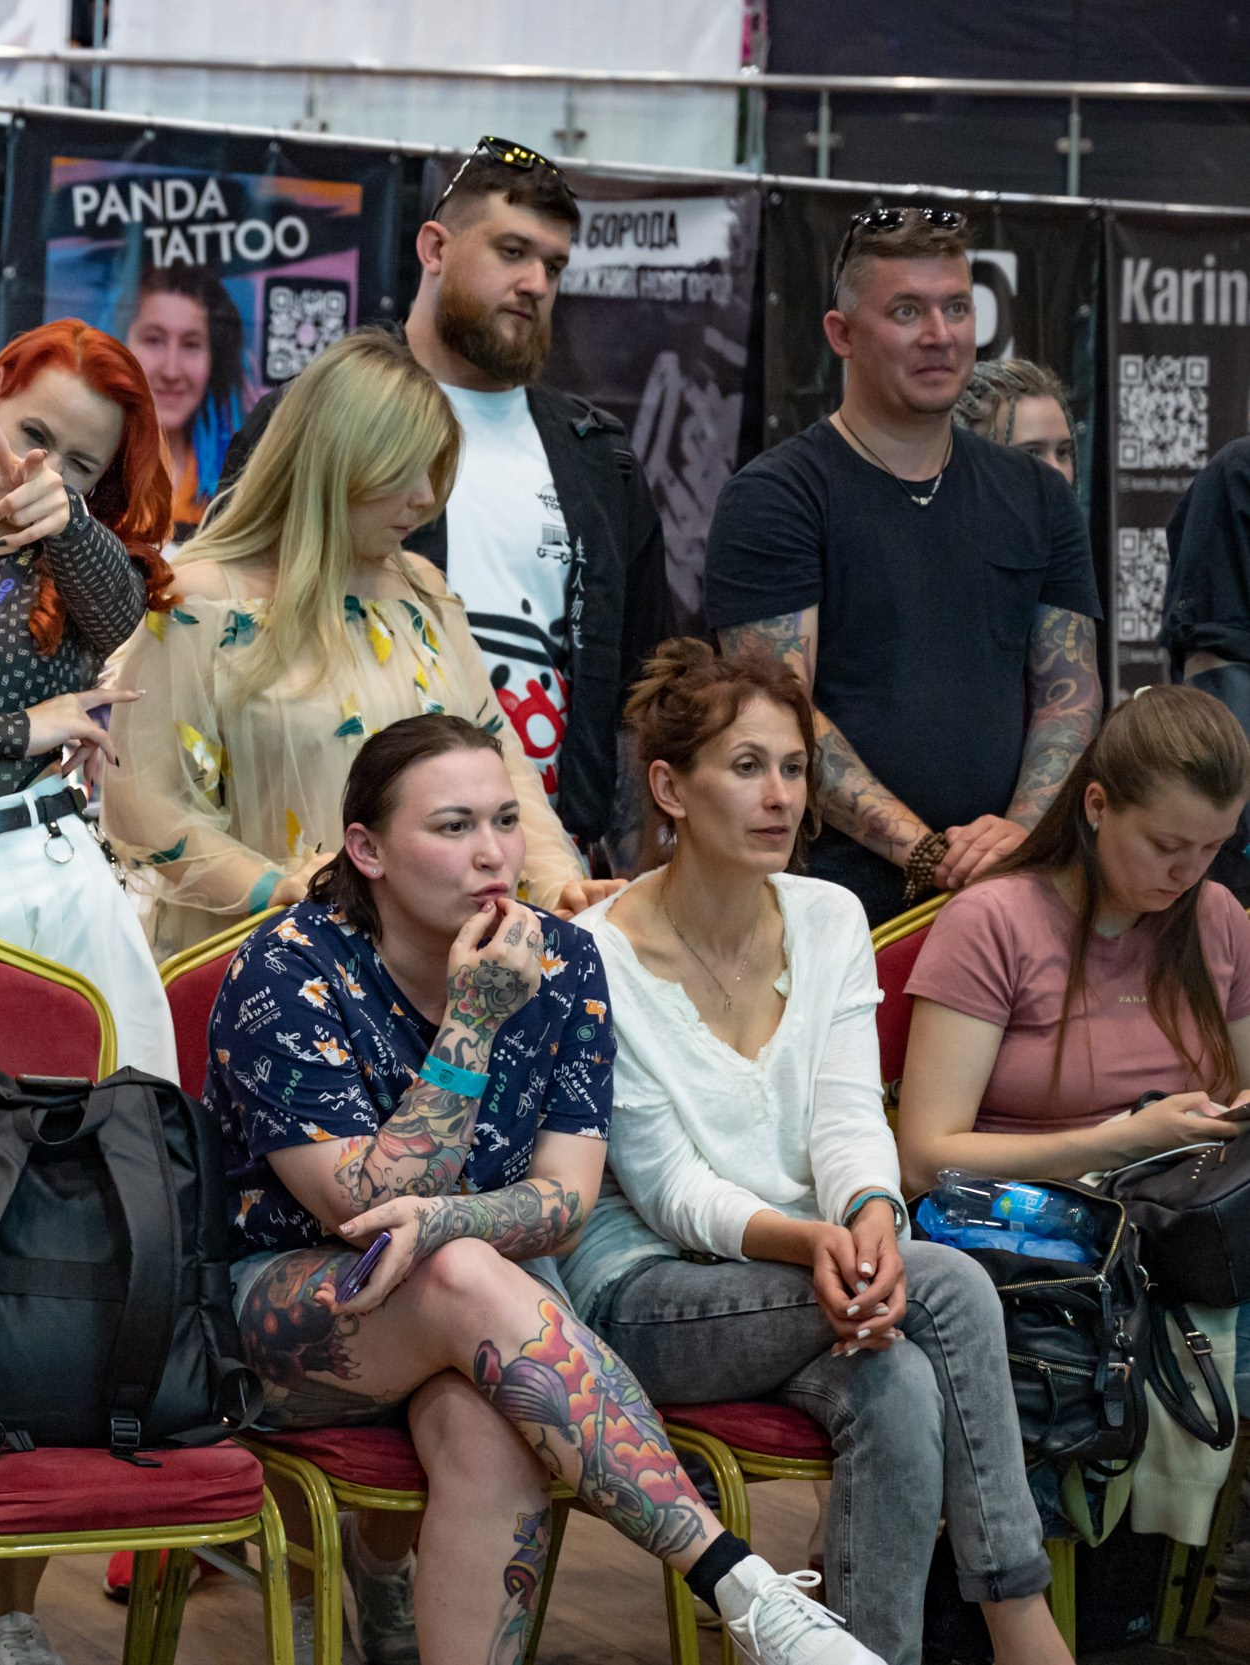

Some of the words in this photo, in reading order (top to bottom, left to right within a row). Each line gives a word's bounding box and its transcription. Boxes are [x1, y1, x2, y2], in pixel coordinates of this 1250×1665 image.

[72, 177, 229, 228] PANDA
[144, 216, 309, 269] TATTOO
[586, 210, 680, 249] БОРОДА
[1120, 253, 1250, 326] Karin
